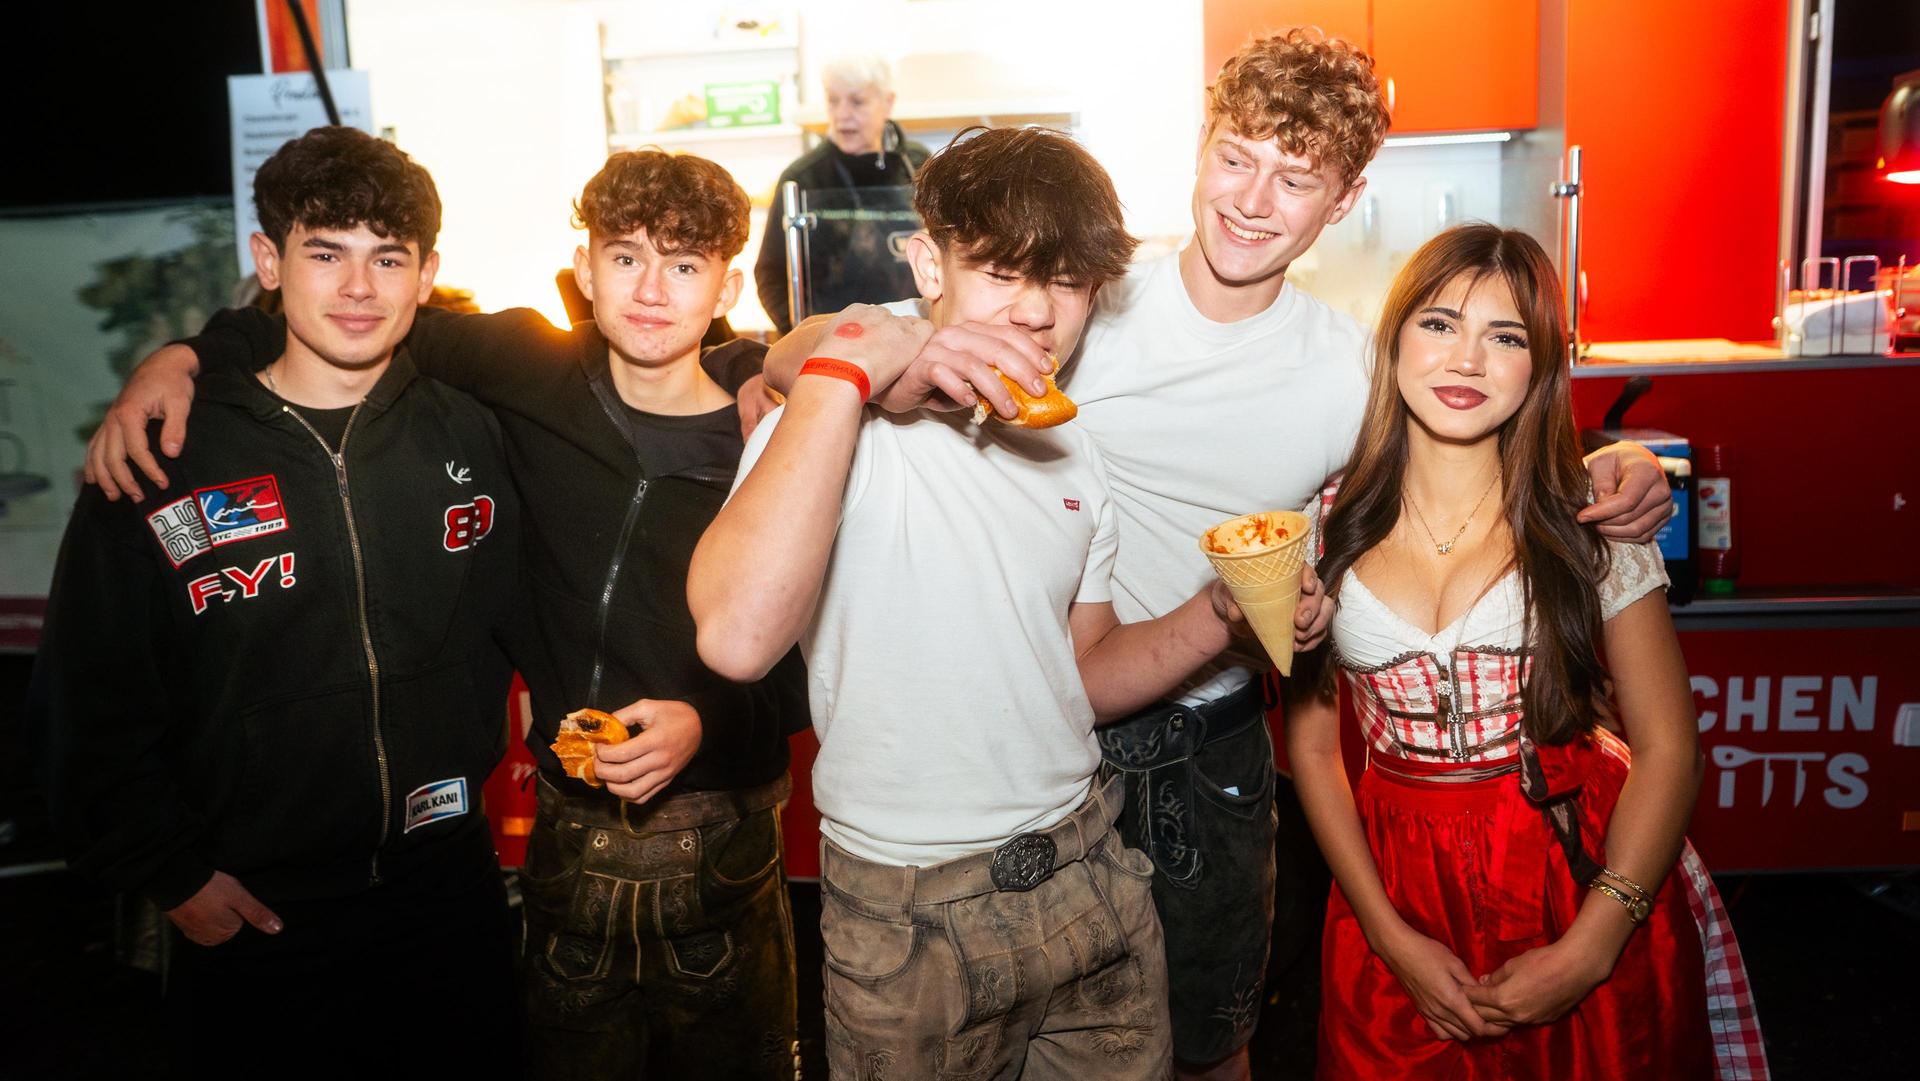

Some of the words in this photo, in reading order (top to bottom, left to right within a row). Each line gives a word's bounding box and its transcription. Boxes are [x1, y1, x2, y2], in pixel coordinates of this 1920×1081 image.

[255, 521, 282, 533] 1989
[1689, 674, 1878, 733] CHEN
[431, 792, 458, 808] KANI
